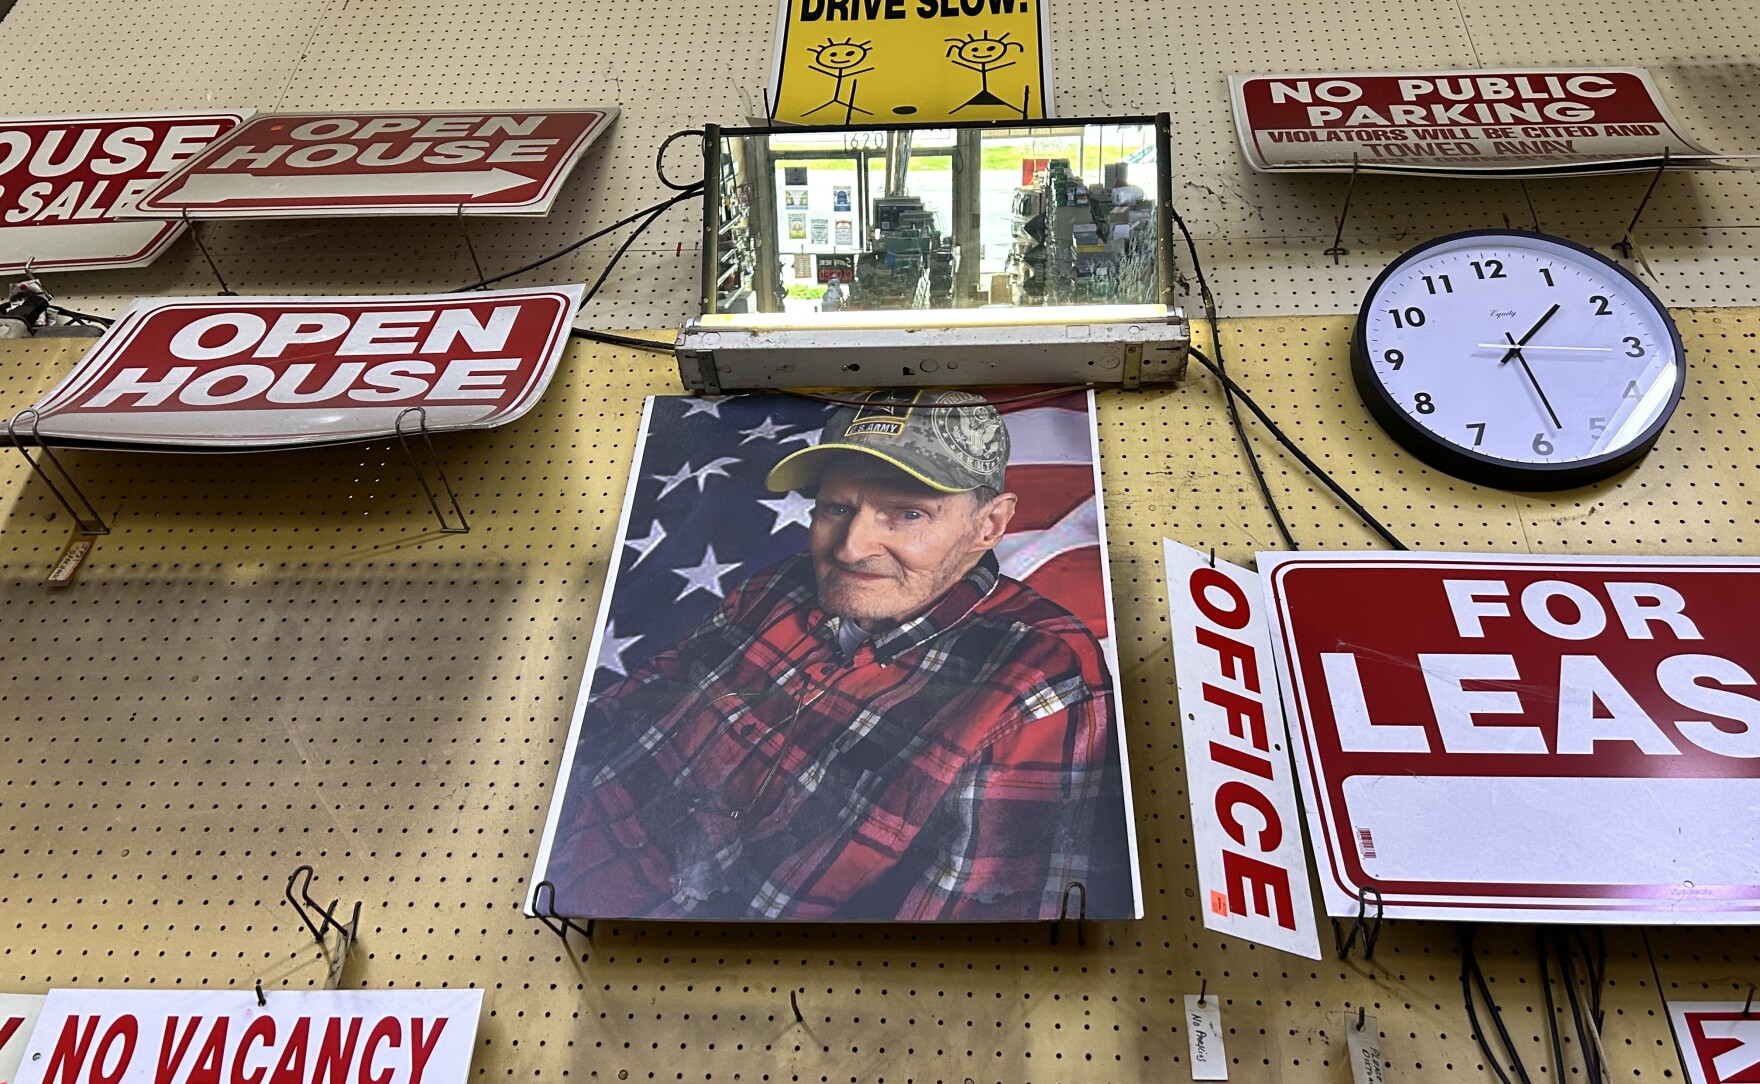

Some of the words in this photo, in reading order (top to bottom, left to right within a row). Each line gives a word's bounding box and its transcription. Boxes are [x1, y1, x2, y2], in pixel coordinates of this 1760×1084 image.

[1269, 80, 1363, 104] NO
[1397, 75, 1617, 101] PUBLIC
[1306, 101, 1596, 127] PARKING
[289, 116, 551, 141] OPEN
[1267, 128, 1409, 143] VIOLATORS
[1411, 127, 1479, 140] WILL
[1480, 127, 1518, 139] BE
[1521, 125, 1599, 138] CITED
[1603, 124, 1660, 137] AND
[843, 132, 884, 150] 1620
[1361, 142, 1481, 158] TOWED
[1493, 140, 1578, 155] AWAY
[207, 138, 560, 169] HOUSE
[1470, 259, 1507, 280] 12
[1539, 268, 1554, 287] 1
[1421, 274, 1453, 295] 11
[1489, 309, 1517, 319] Equity
[1589, 295, 1613, 316] 2
[1388, 307, 1426, 328] 10
[169, 304, 522, 361] OPEN
[1622, 336, 1645, 358] 3
[1384, 349, 1404, 371] 9
[81, 357, 522, 406] HOUSE
[1414, 392, 1435, 415] 8
[865, 422, 898, 433] ARMY
[1466, 422, 1486, 446] 7
[1589, 417, 1609, 440] 5
[1532, 433, 1554, 456] 6
[1442, 579, 1704, 640] FOR
[1320, 652, 1760, 758] LEAS
[1189, 567, 1297, 931] OFFICE
[42, 1014, 138, 1084] NO
[154, 1015, 449, 1084] VACANCY
